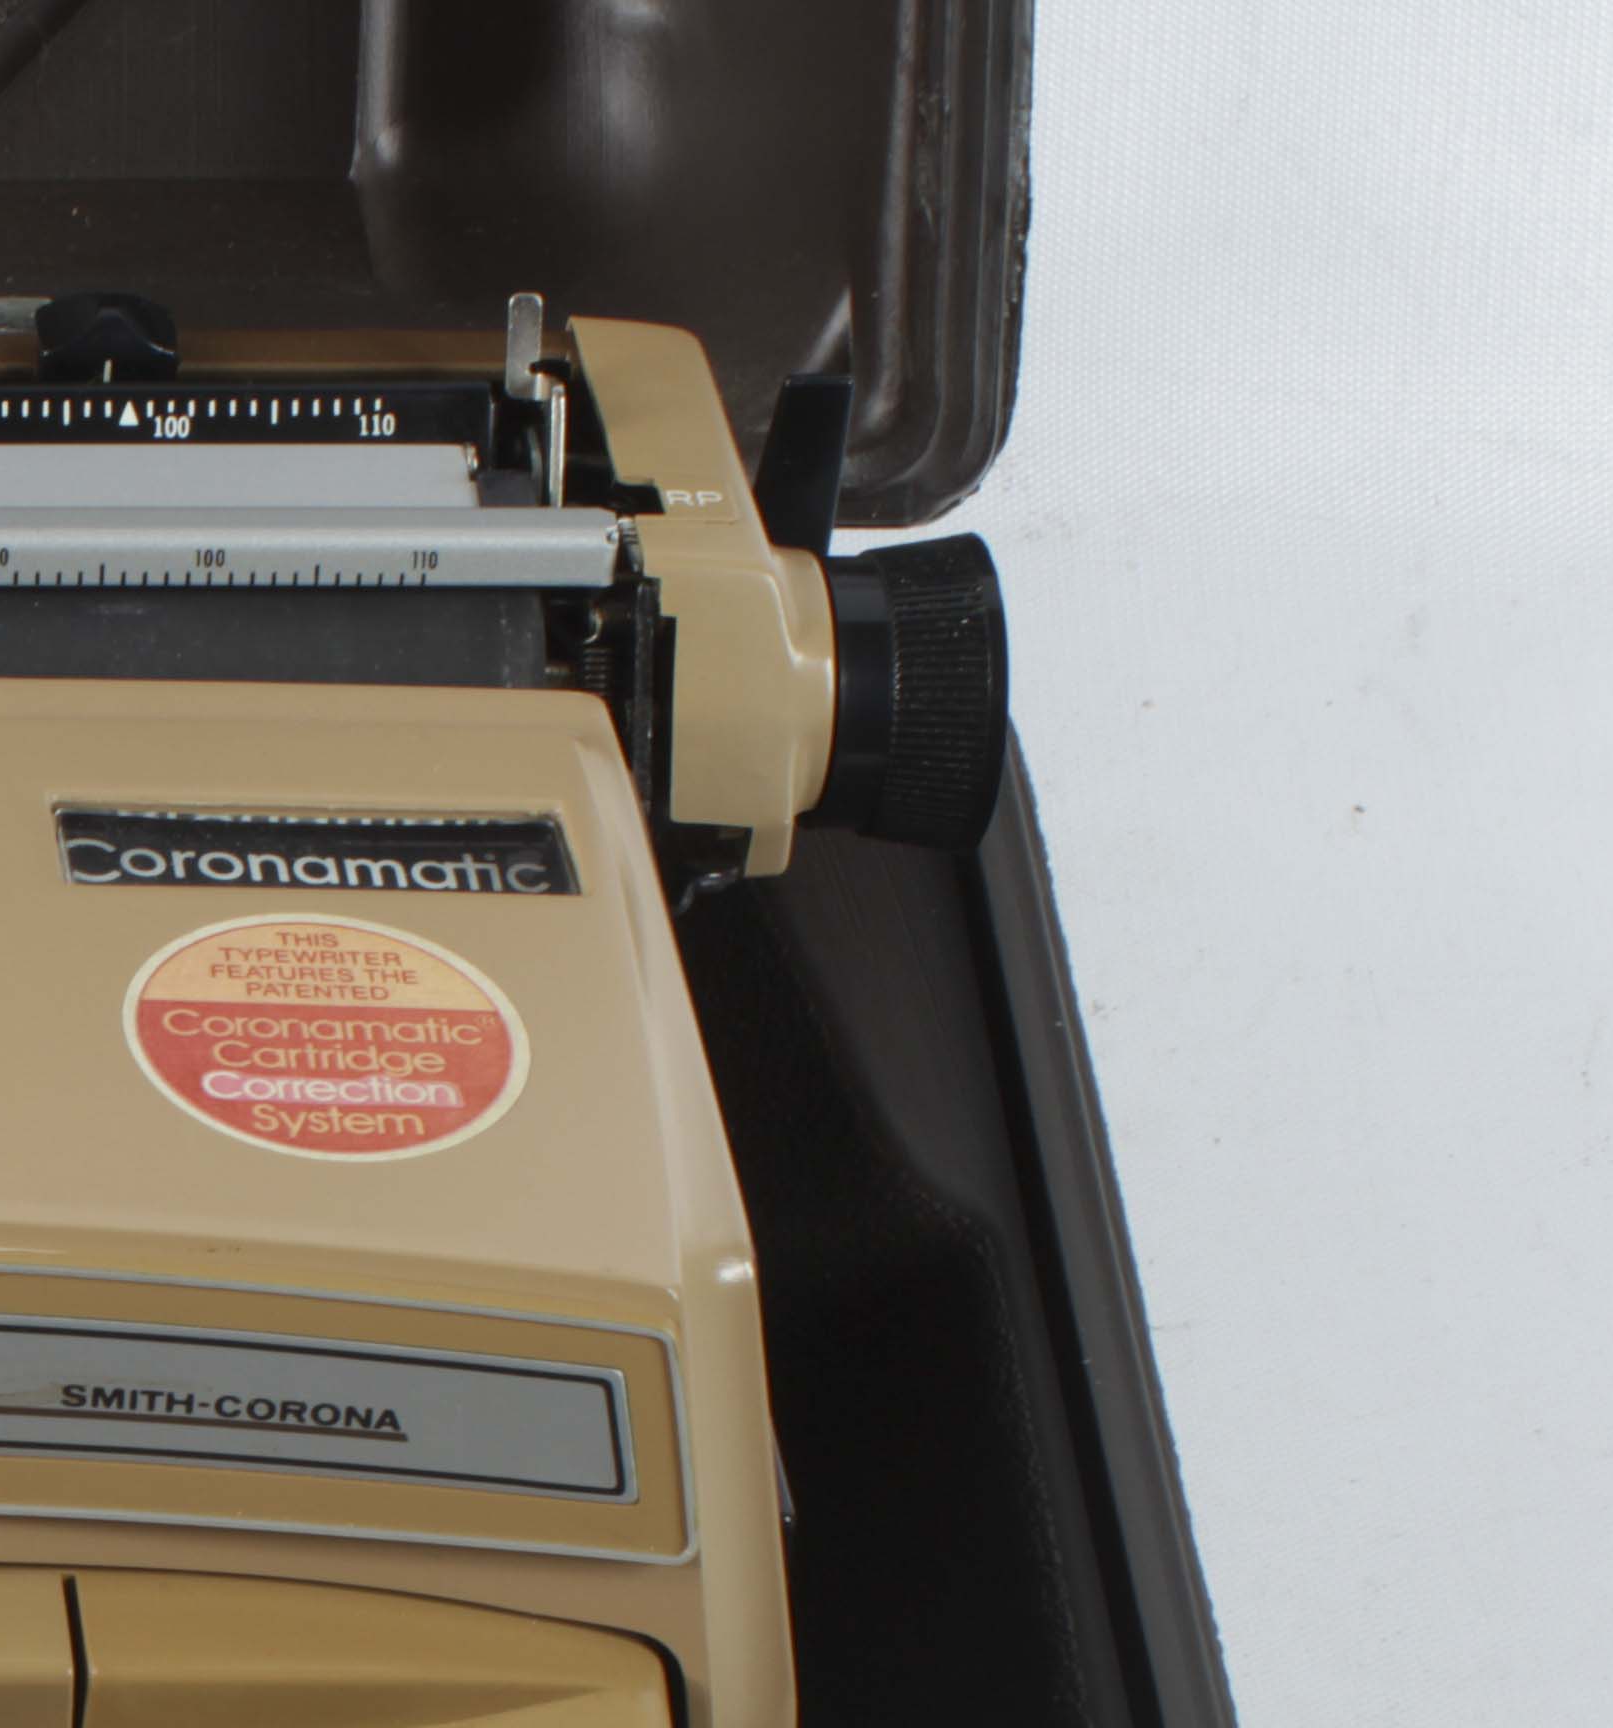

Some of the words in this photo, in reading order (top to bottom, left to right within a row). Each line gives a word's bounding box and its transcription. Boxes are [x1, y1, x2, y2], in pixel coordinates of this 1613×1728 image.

[154, 416, 191, 438] 100
[359, 415, 396, 437] 110
[195, 548, 225, 567] 100
[412, 550, 438, 569] 110
[65, 838, 550, 893] Coronamatic
[276, 932, 339, 948] THIS
[218, 947, 402, 966] TYPEWRITER
[209, 964, 355, 983] FEATURES
[363, 969, 419, 985] THE
[246, 982, 389, 1000] PATENTED
[211, 1040, 446, 1077] Cartridge
[202, 1071, 459, 1105] Correction
[252, 1105, 425, 1137] System
[60, 1383, 403, 1433] SMITH-CORONA
